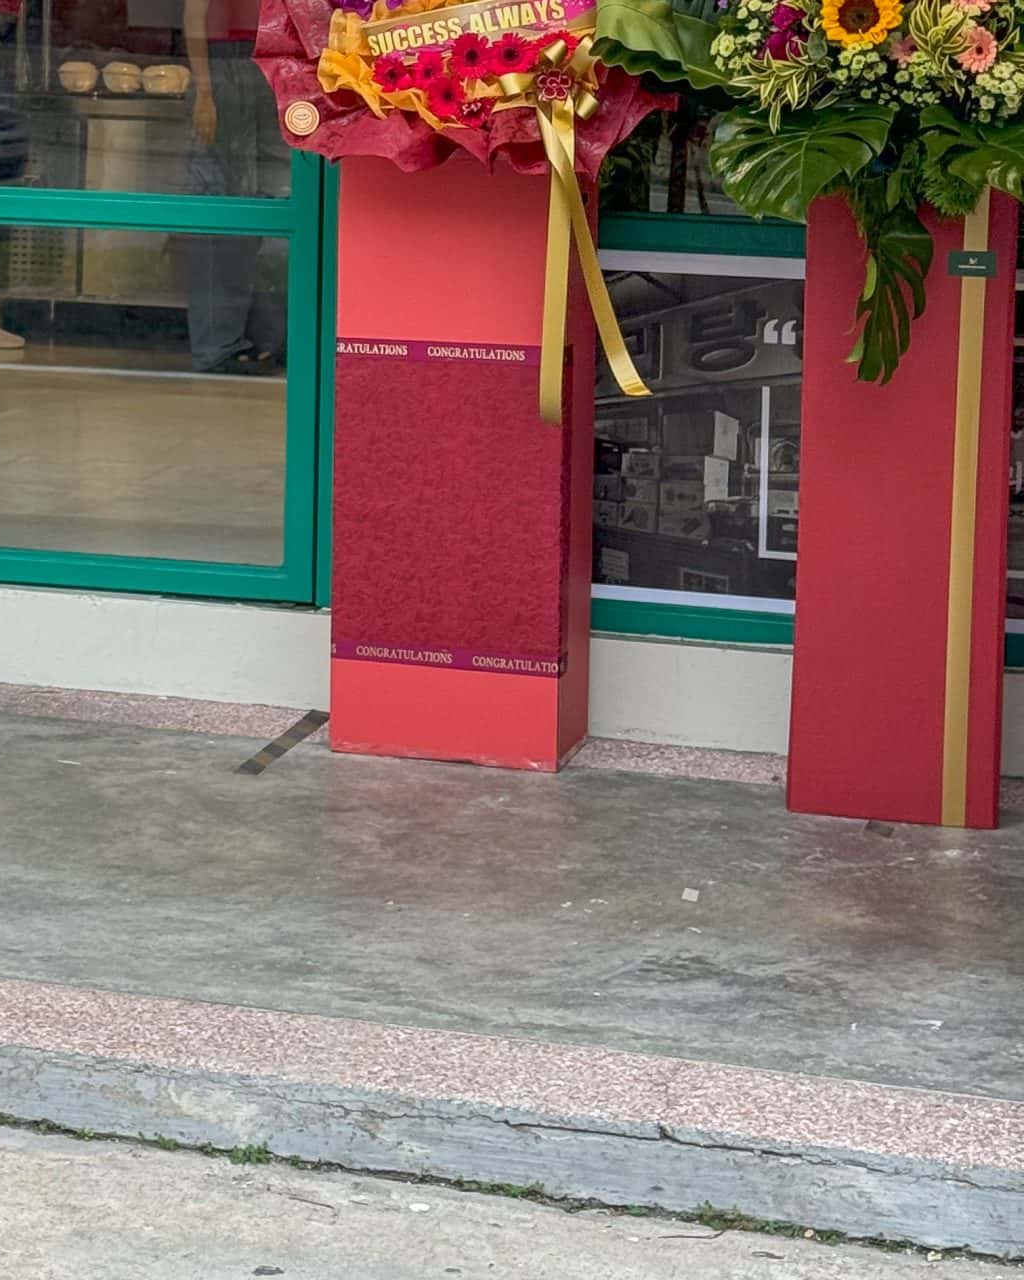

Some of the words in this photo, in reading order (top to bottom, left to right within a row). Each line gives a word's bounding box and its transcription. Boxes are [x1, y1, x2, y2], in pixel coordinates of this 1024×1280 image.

[367, 17, 462, 56] SUCCESS
[427, 345, 526, 361] CONGRATULATIONS
[356, 644, 453, 664] CONGRATULATIONS
